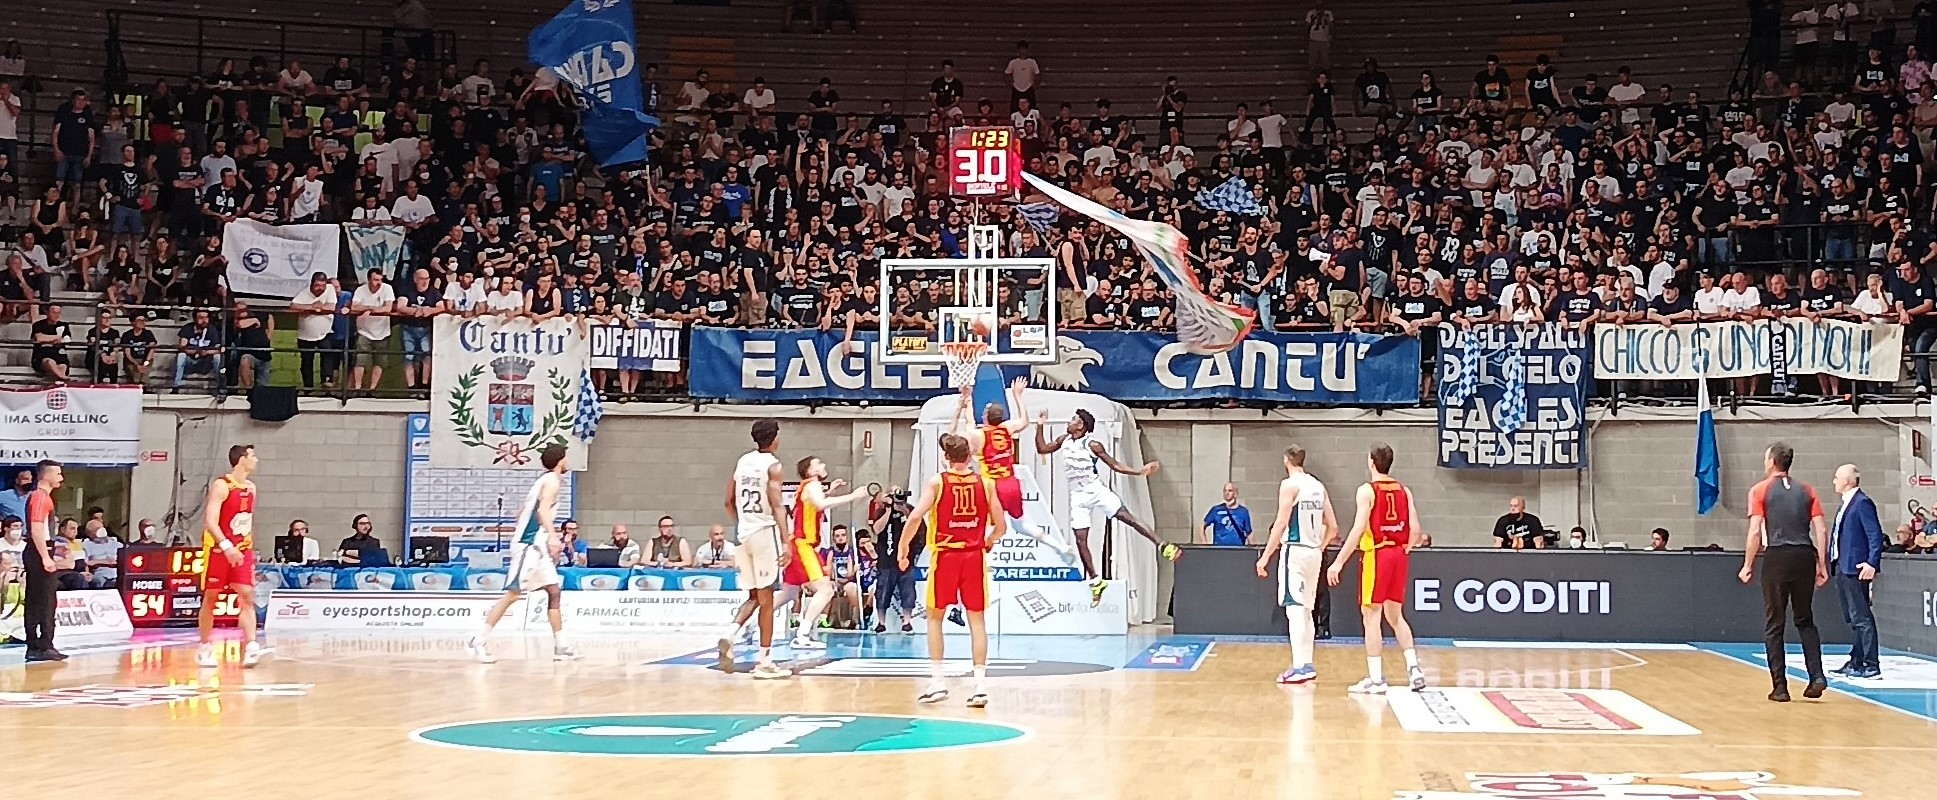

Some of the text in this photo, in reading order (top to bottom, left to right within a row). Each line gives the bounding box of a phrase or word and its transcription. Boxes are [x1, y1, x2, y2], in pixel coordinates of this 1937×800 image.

[971, 131, 1009, 147] 1:23
[955, 149, 1007, 183] 3.0
[592, 327, 680, 359] DIFFIDATI
[1600, 328, 1680, 374] CHICCO
[1153, 339, 1370, 392] CANTU'
[1443, 353, 1495, 385] DL
[5, 413, 109, 425] IMA SCHELLING
[37, 428, 76, 436] GROUP
[1441, 430, 1579, 467] PRESENTI
[741, 488, 763, 513] 23
[952, 484, 978, 516] 11
[1385, 492, 1398, 521] 1
[172, 550, 205, 573] 1:2
[131, 593, 165, 617] 54
[1414, 579, 1610, 614] E GODITI
[322, 604, 471, 619] eyesportshop.com
[576, 607, 641, 617] FARMACIE
